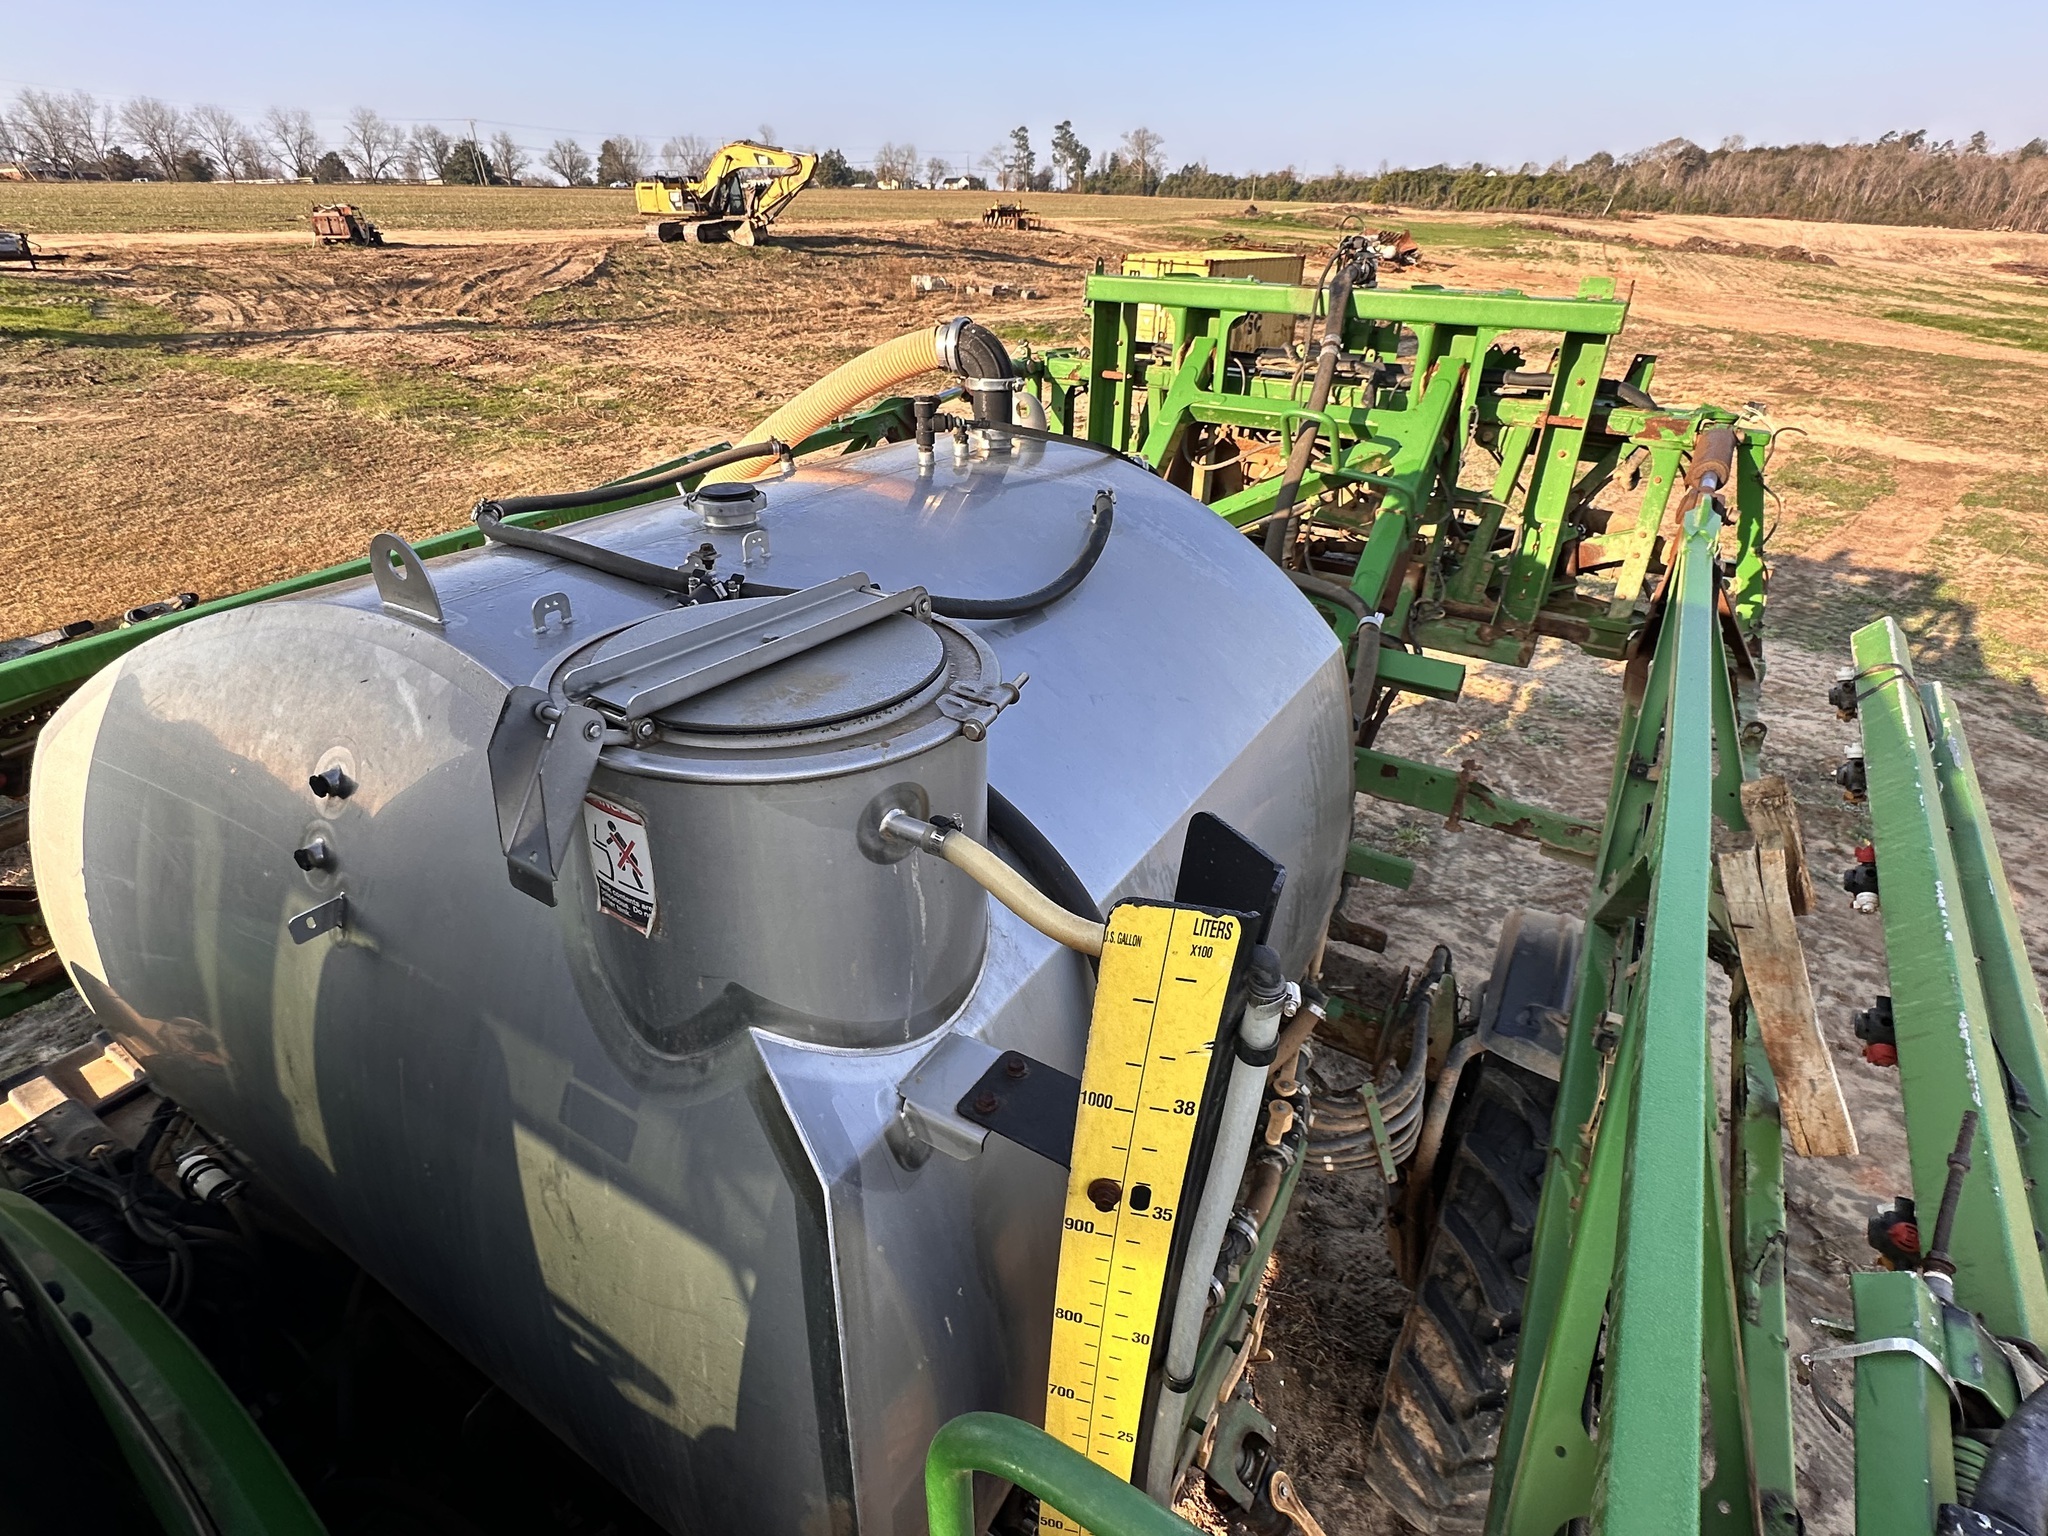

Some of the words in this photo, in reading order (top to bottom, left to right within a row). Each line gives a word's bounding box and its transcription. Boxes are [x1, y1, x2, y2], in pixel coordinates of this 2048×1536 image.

[632, 905, 643, 916] Do
[1193, 917, 1234, 940] LITERS
[1117, 932, 1142, 948] GALLON
[1189, 944, 1213, 959] X100
[1080, 1090, 1113, 1109] 1000
[1173, 1099, 1196, 1116] 38
[1152, 1206, 1173, 1222] 35
[1064, 1217, 1094, 1234] 900
[1055, 1307, 1083, 1324] 800
[1131, 1332, 1150, 1345] 30
[1048, 1383, 1075, 1399] 700
[1117, 1430, 1134, 1443] 25
[1040, 1516, 1063, 1530] 500
